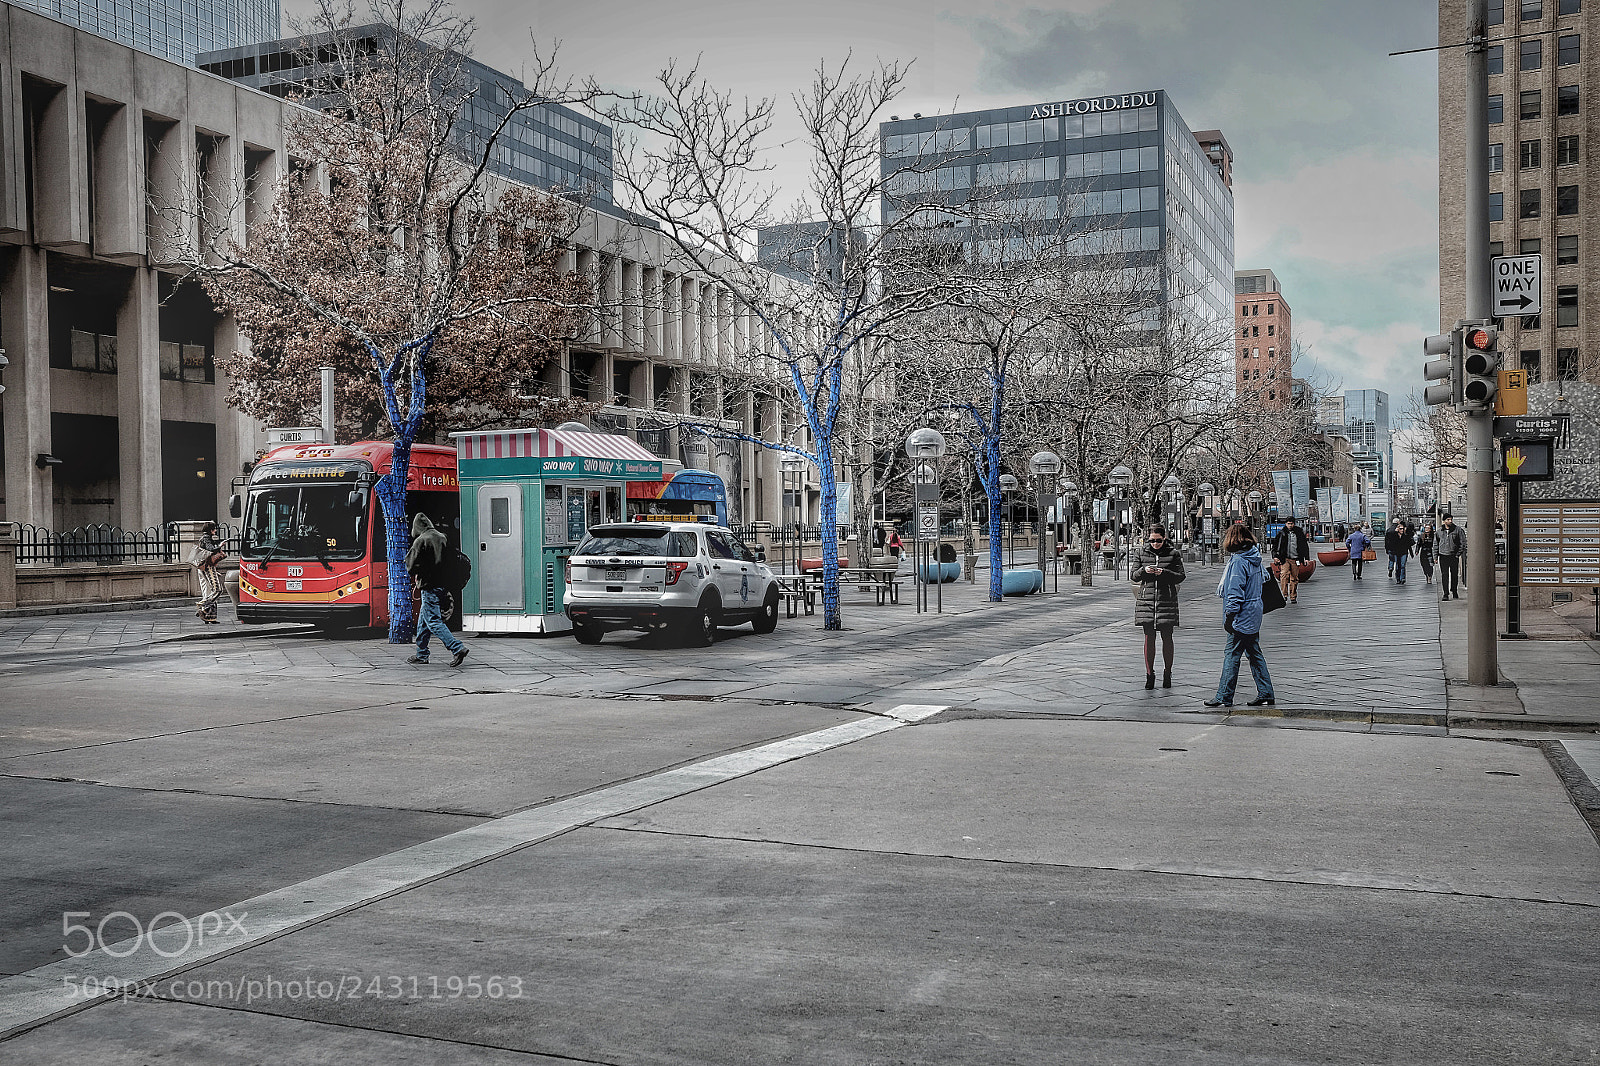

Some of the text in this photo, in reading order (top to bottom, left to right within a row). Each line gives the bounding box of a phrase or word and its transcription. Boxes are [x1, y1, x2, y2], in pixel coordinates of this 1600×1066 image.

[1030, 92, 1157, 119] ASHFORD.EDU
[1499, 260, 1535, 276] ONE
[1498, 277, 1535, 292] WAY
[1515, 419, 1551, 428] Curtis
[280, 432, 302, 441] CURTIS
[543, 461, 576, 471] SNO WAY
[584, 459, 614, 474] SNO WAY
[326, 538, 337, 547] 50
